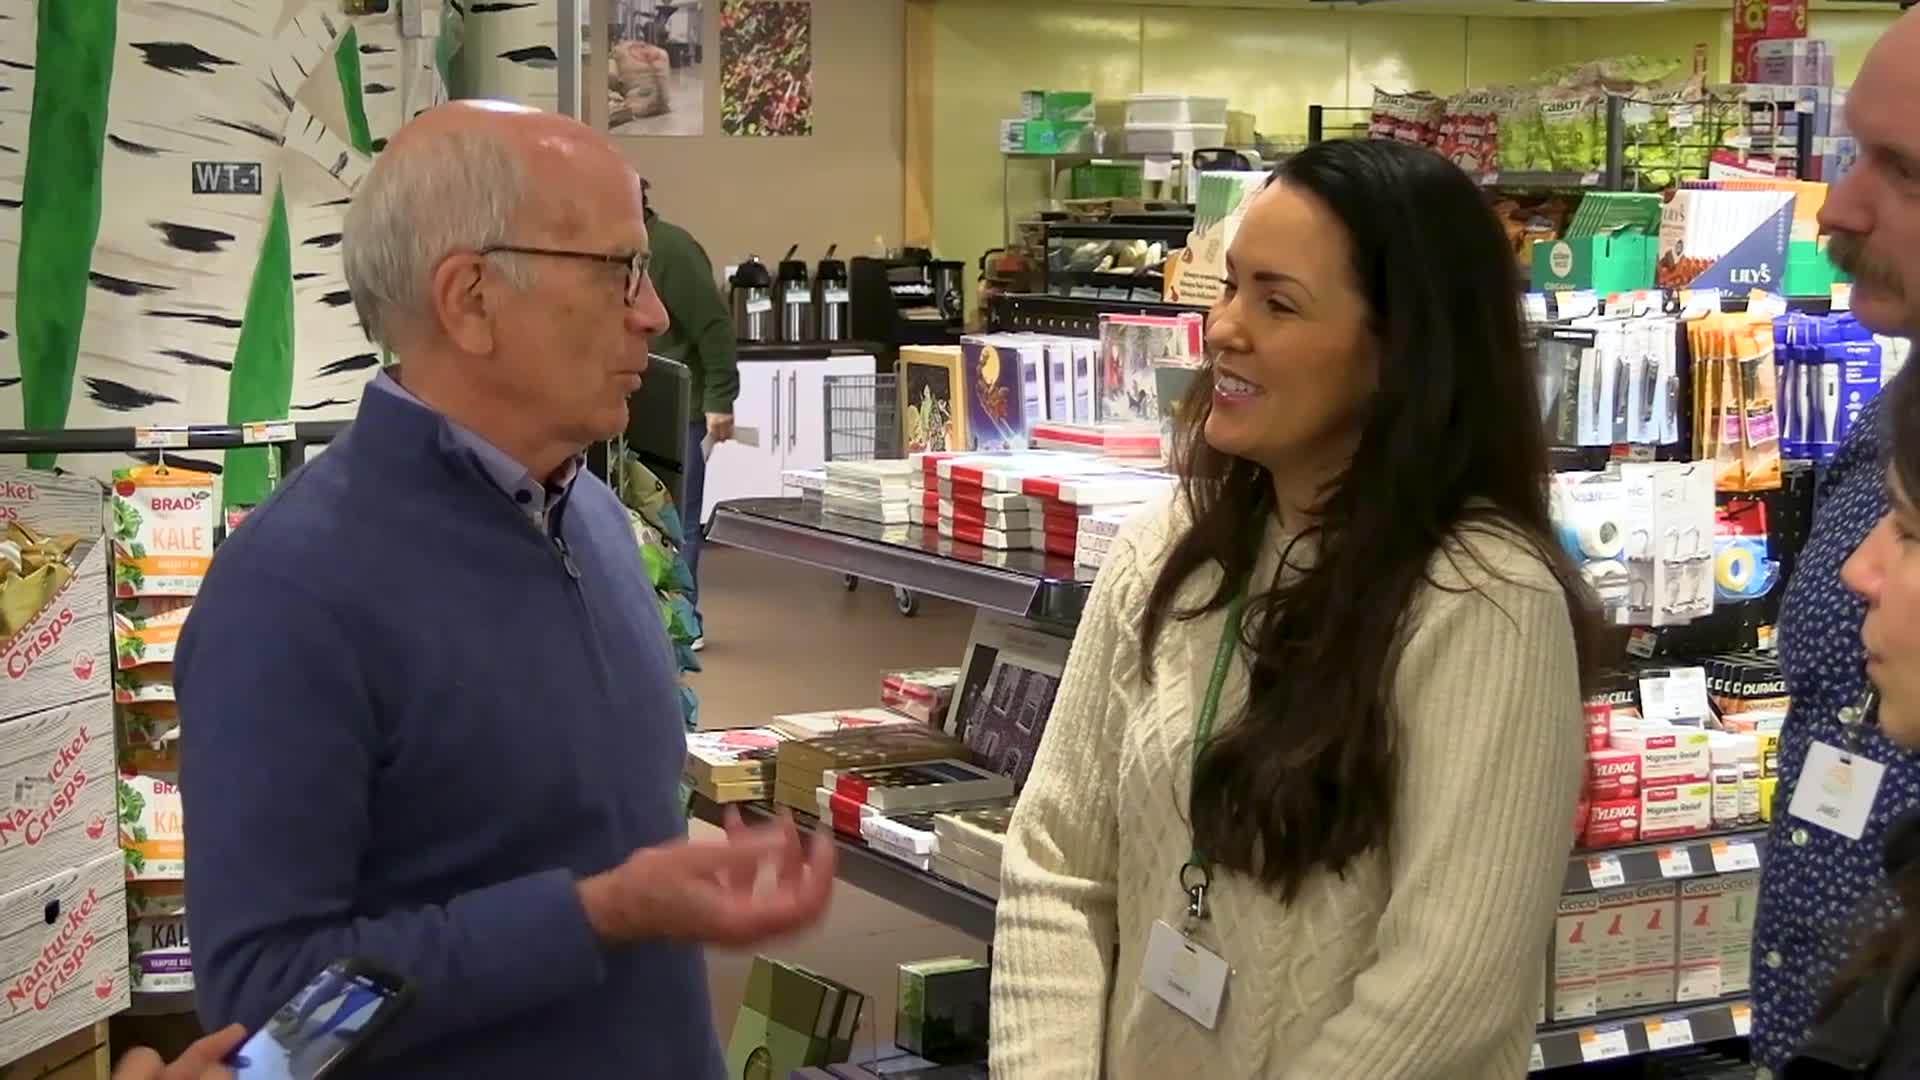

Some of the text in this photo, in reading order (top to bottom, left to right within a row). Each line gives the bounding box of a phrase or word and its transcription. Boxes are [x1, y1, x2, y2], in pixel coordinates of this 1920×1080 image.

[195, 163, 259, 191] WT-1
[1730, 263, 1771, 284] LILY'S
[153, 528, 203, 551] KALE
[8, 608, 73, 679] Crisps
[1743, 682, 1786, 695] DURACE
[153, 782, 180, 795] BRA
[25, 770, 86, 845] Crisps
[1592, 805, 1637, 820] TYLENOL
[155, 812, 183, 833] KA
[152, 923, 189, 947] KAL
[6, 887, 99, 1012] Nantucket
[34, 931, 94, 1010] Crisps
